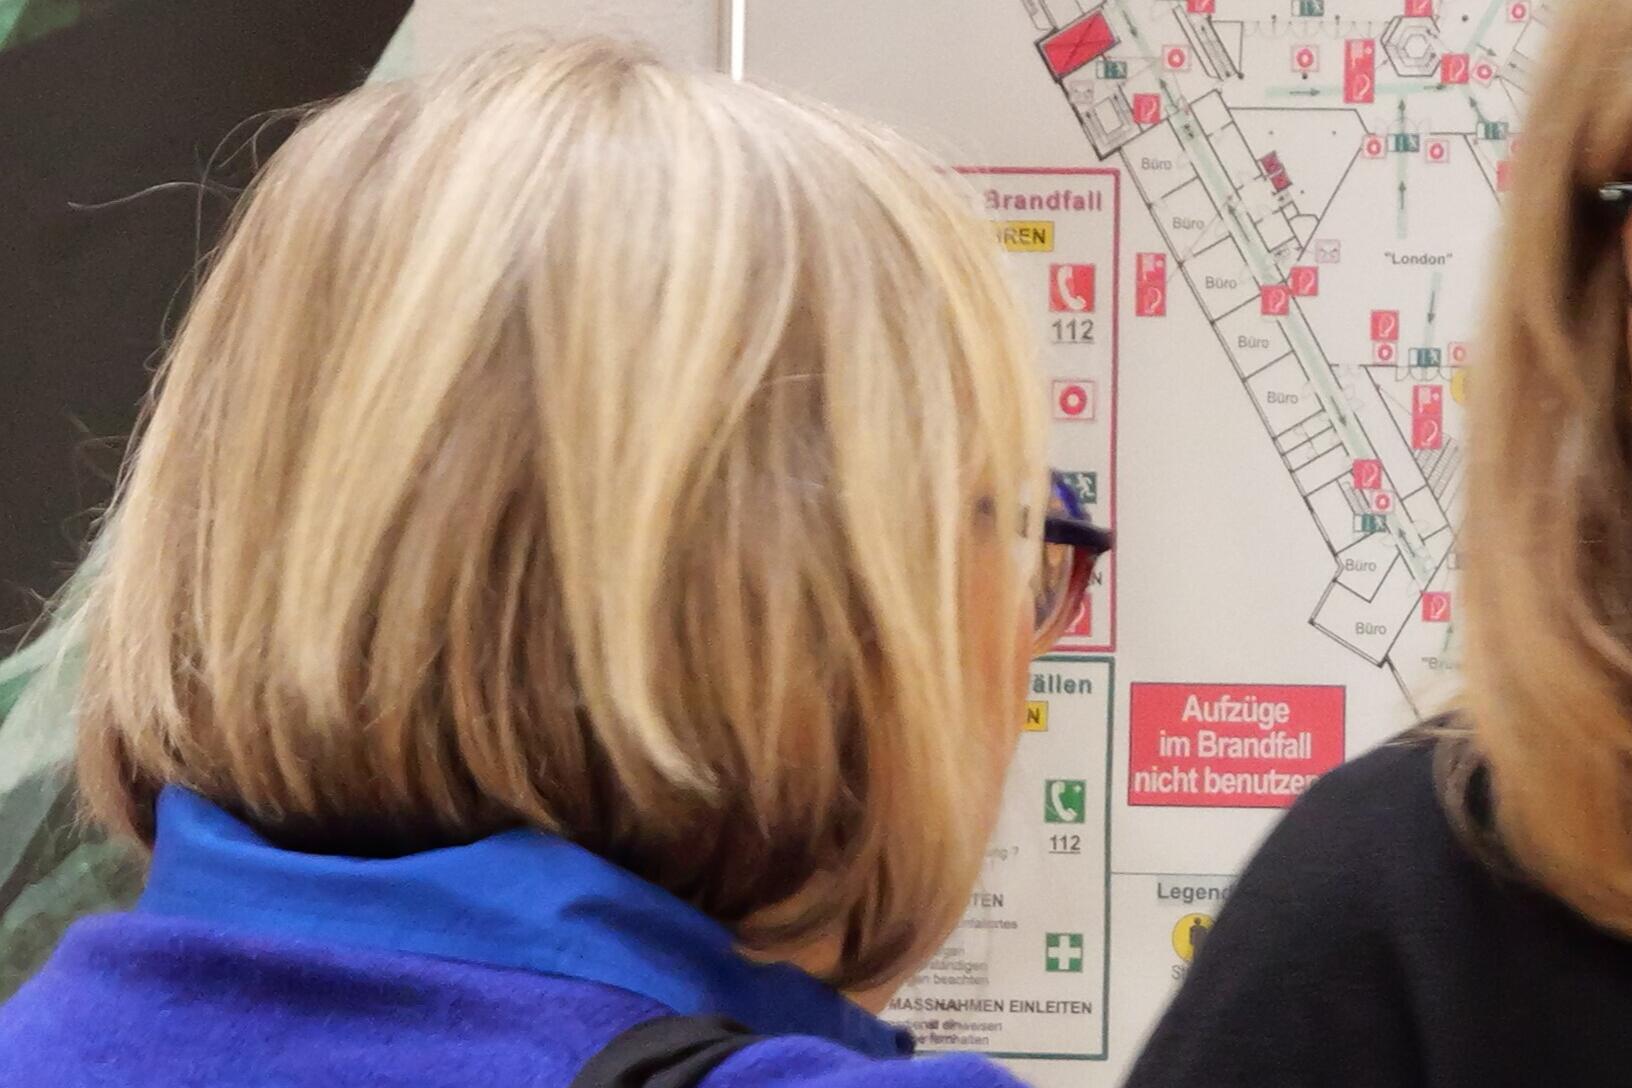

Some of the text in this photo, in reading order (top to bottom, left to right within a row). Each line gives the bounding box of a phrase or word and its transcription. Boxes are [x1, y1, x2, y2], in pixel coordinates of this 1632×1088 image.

[1141, 157, 1172, 170] Büro
[984, 189, 1102, 211] Brandfall
[1172, 217, 1204, 230] Büro
[1384, 252, 1453, 266] "London"
[1205, 276, 1237, 289] Büro
[1051, 319, 1095, 341] 112
[1237, 335, 1270, 349] Büro
[1267, 390, 1298, 404] Büro
[1345, 559, 1377, 572] Büro
[1355, 622, 1387, 636] Büro
[1032, 674, 1093, 694] ällen
[1181, 694, 1291, 730] Aufzüge
[1159, 730, 1312, 760] im Brandfall
[1134, 765, 1198, 794] nicht
[1050, 834, 1081, 851] 112
[1009, 1000, 1093, 1015] EINLEITEN
